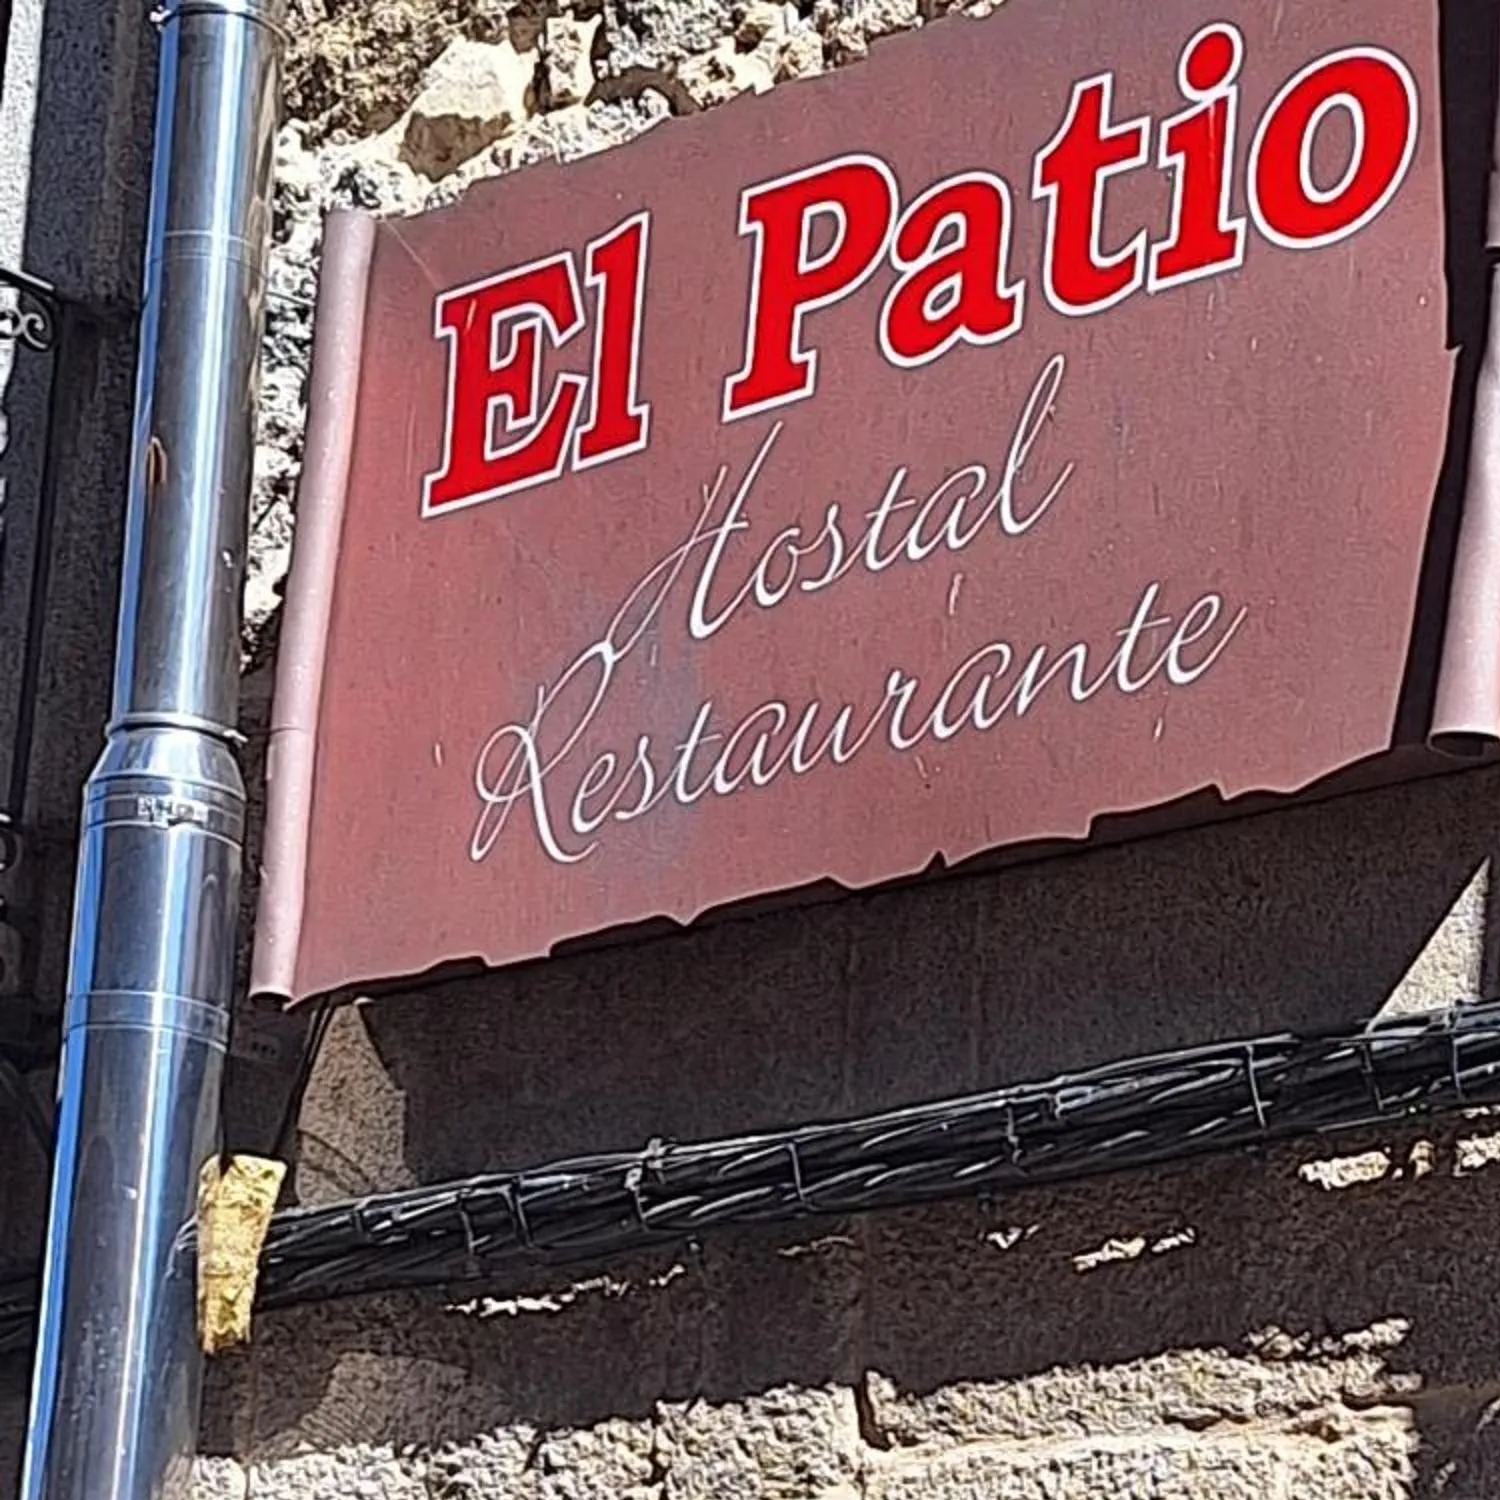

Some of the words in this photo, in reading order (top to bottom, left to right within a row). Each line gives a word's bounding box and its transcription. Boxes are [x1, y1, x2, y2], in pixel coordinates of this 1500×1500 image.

[421, 211, 651, 519] El
[722, 22, 1419, 422] Patio
[604, 354, 1074, 666] Hostal
[470, 582, 1248, 864] Restaurante
